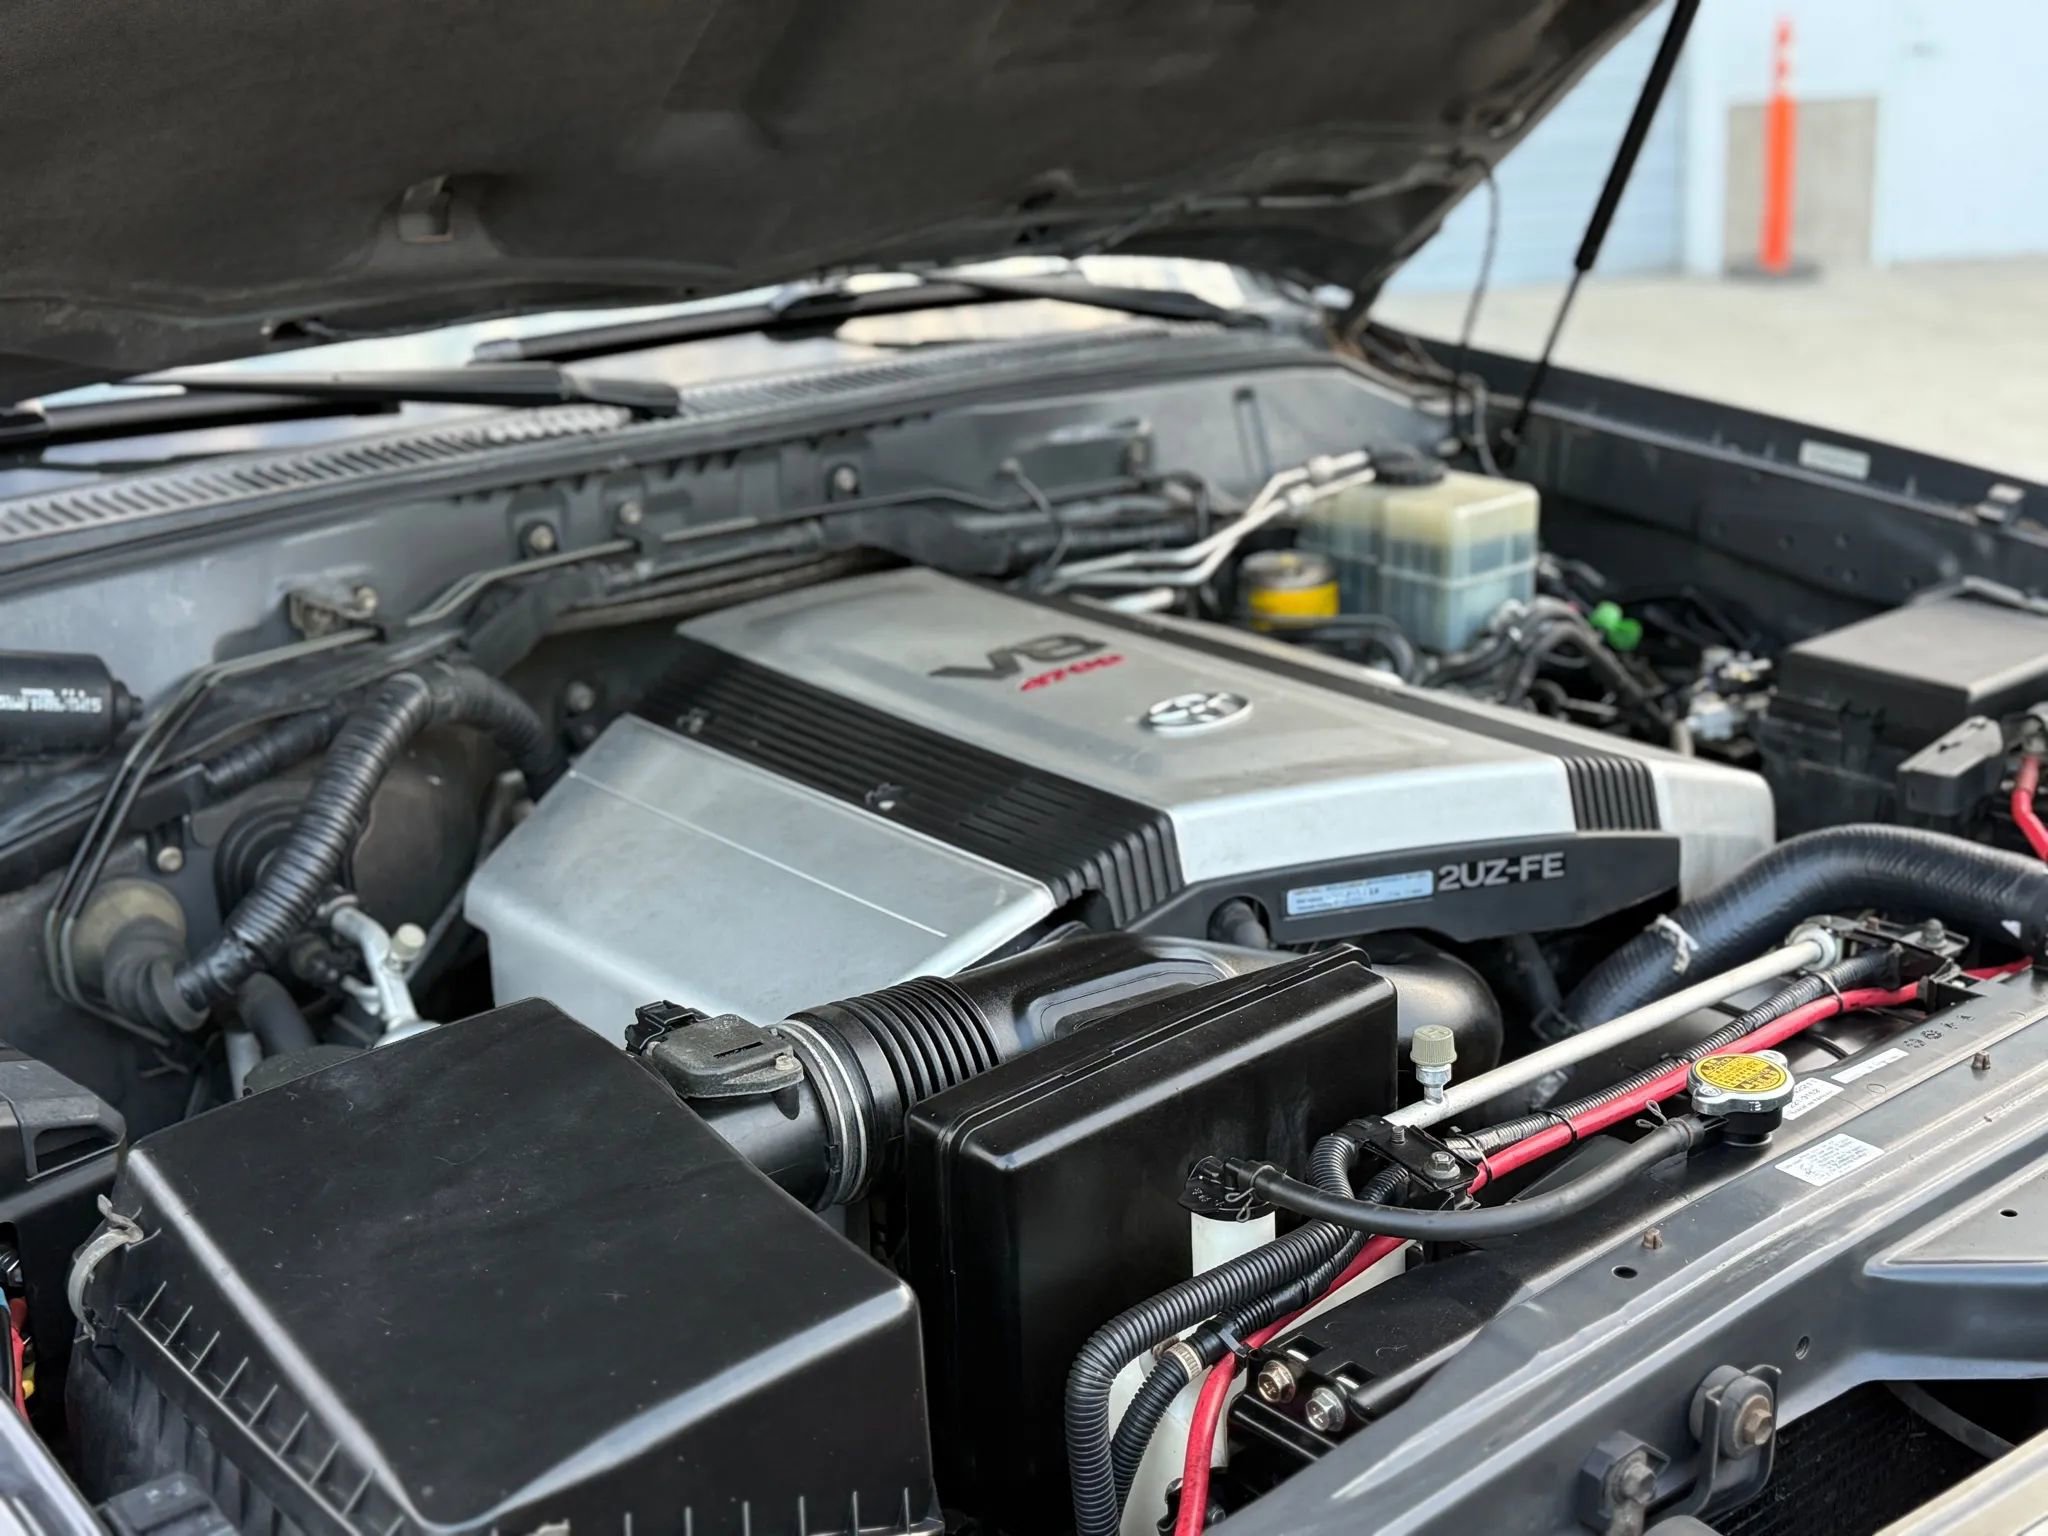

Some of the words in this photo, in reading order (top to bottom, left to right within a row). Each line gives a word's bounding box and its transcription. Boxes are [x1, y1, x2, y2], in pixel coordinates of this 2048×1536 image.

[928, 634, 1109, 681] V8
[1019, 654, 1125, 692] 4700
[1437, 851, 1565, 892] 2UZ-FE
